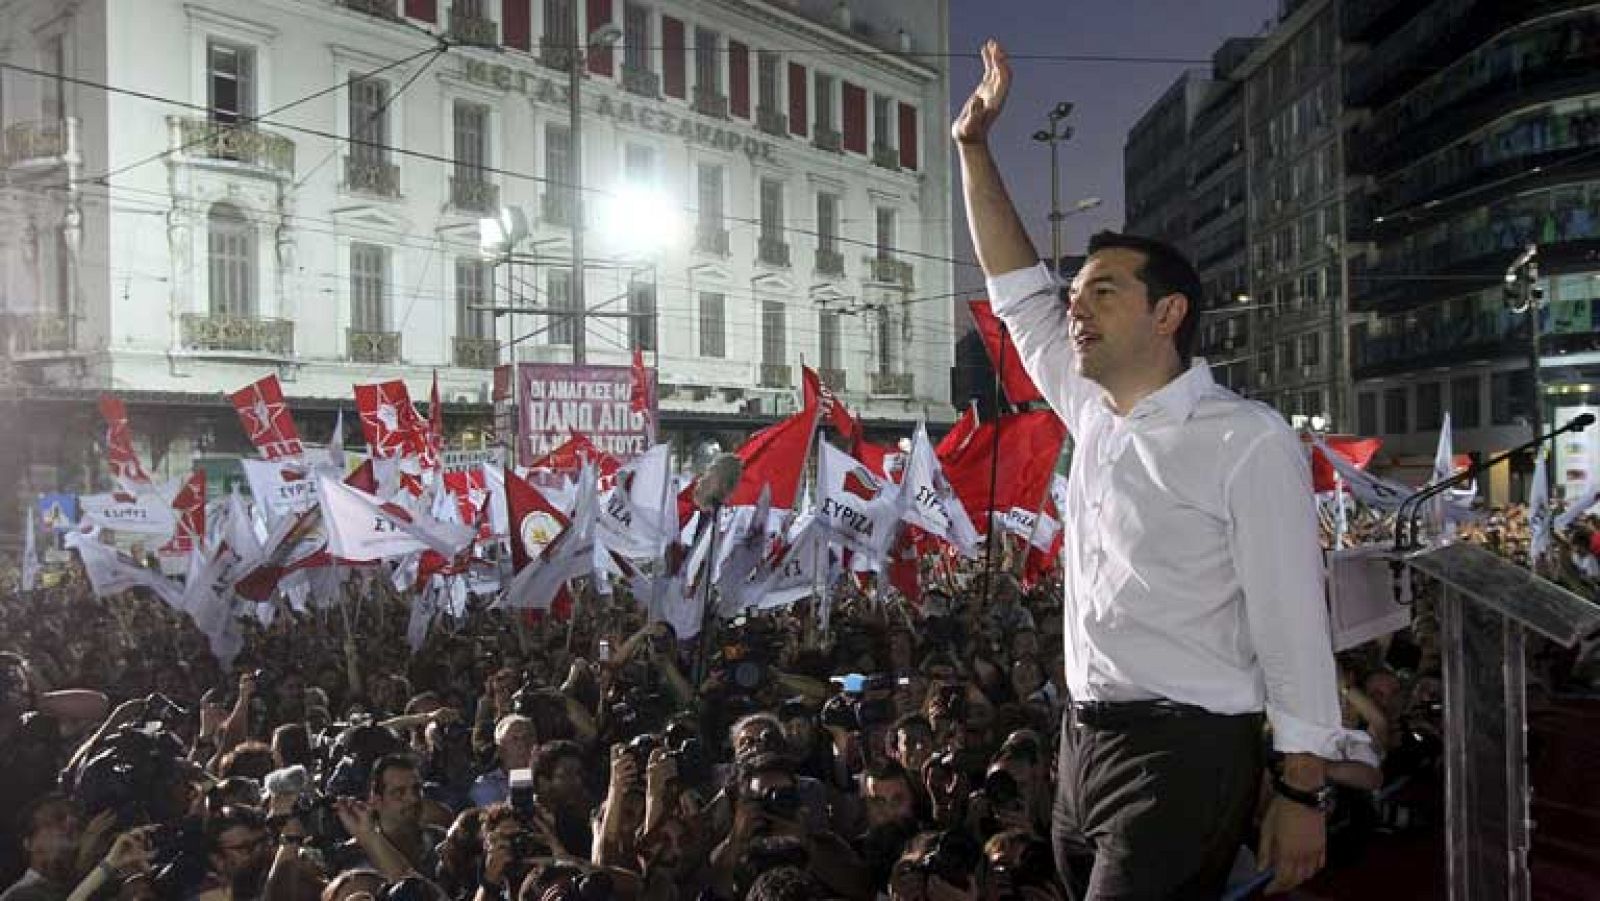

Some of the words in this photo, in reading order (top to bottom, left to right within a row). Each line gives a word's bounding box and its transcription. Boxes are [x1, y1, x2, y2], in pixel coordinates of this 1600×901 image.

[531, 379, 545, 399] ΟΙ
[530, 401, 593, 431] ΠΑΝΩ
[821, 497, 874, 537] ΣΥΡΙΖΑ
